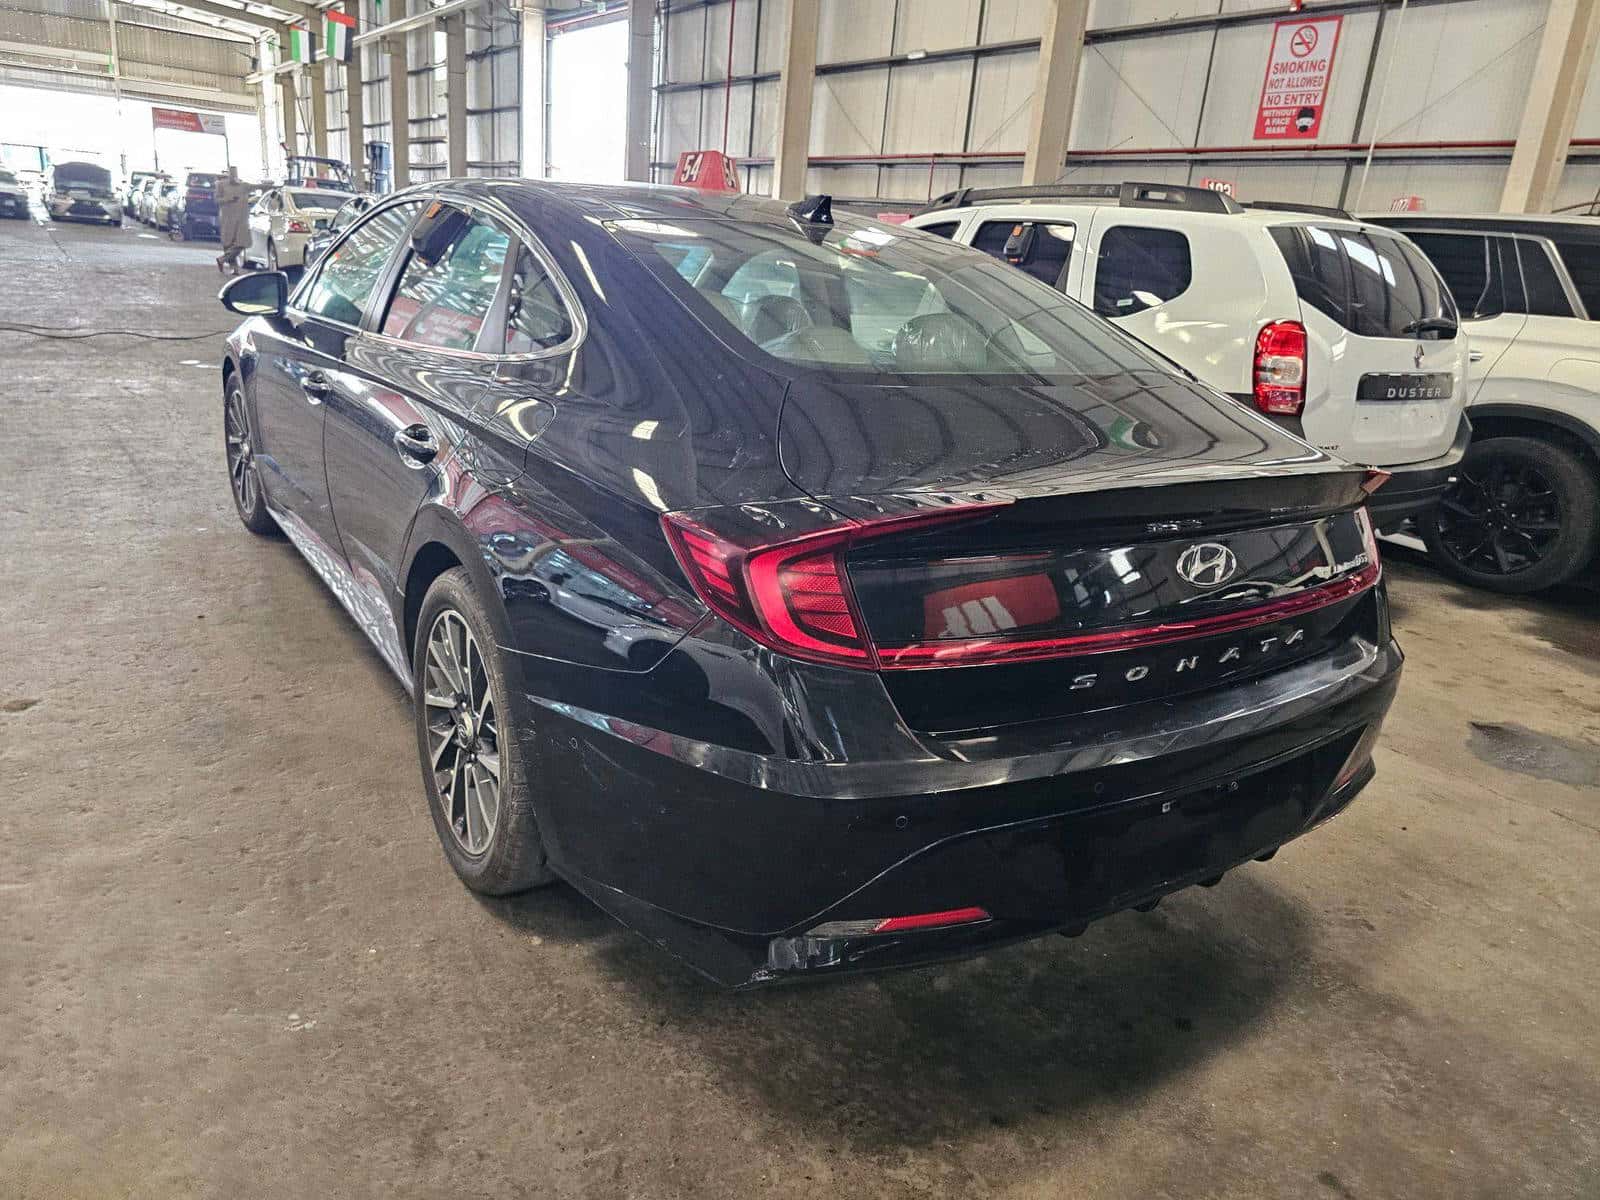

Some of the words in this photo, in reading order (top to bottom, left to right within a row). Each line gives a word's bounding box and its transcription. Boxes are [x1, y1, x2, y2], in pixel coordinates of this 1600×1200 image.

[1272, 60, 1326, 75] SMOKING
[1268, 78, 1285, 90] NOT
[1285, 75, 1324, 89] ALLOWED
[1266, 95, 1281, 105] NO
[1284, 93, 1319, 104] ENTRY
[1263, 109, 1296, 117] WITHOUT
[1265, 118, 1270, 126] A
[1272, 118, 1290, 126] FACE
[680, 153, 704, 183] 54
[722, 156, 736, 187] 54
[1386, 387, 1441, 399] DUSTER
[1069, 628, 1305, 691] SONATA
